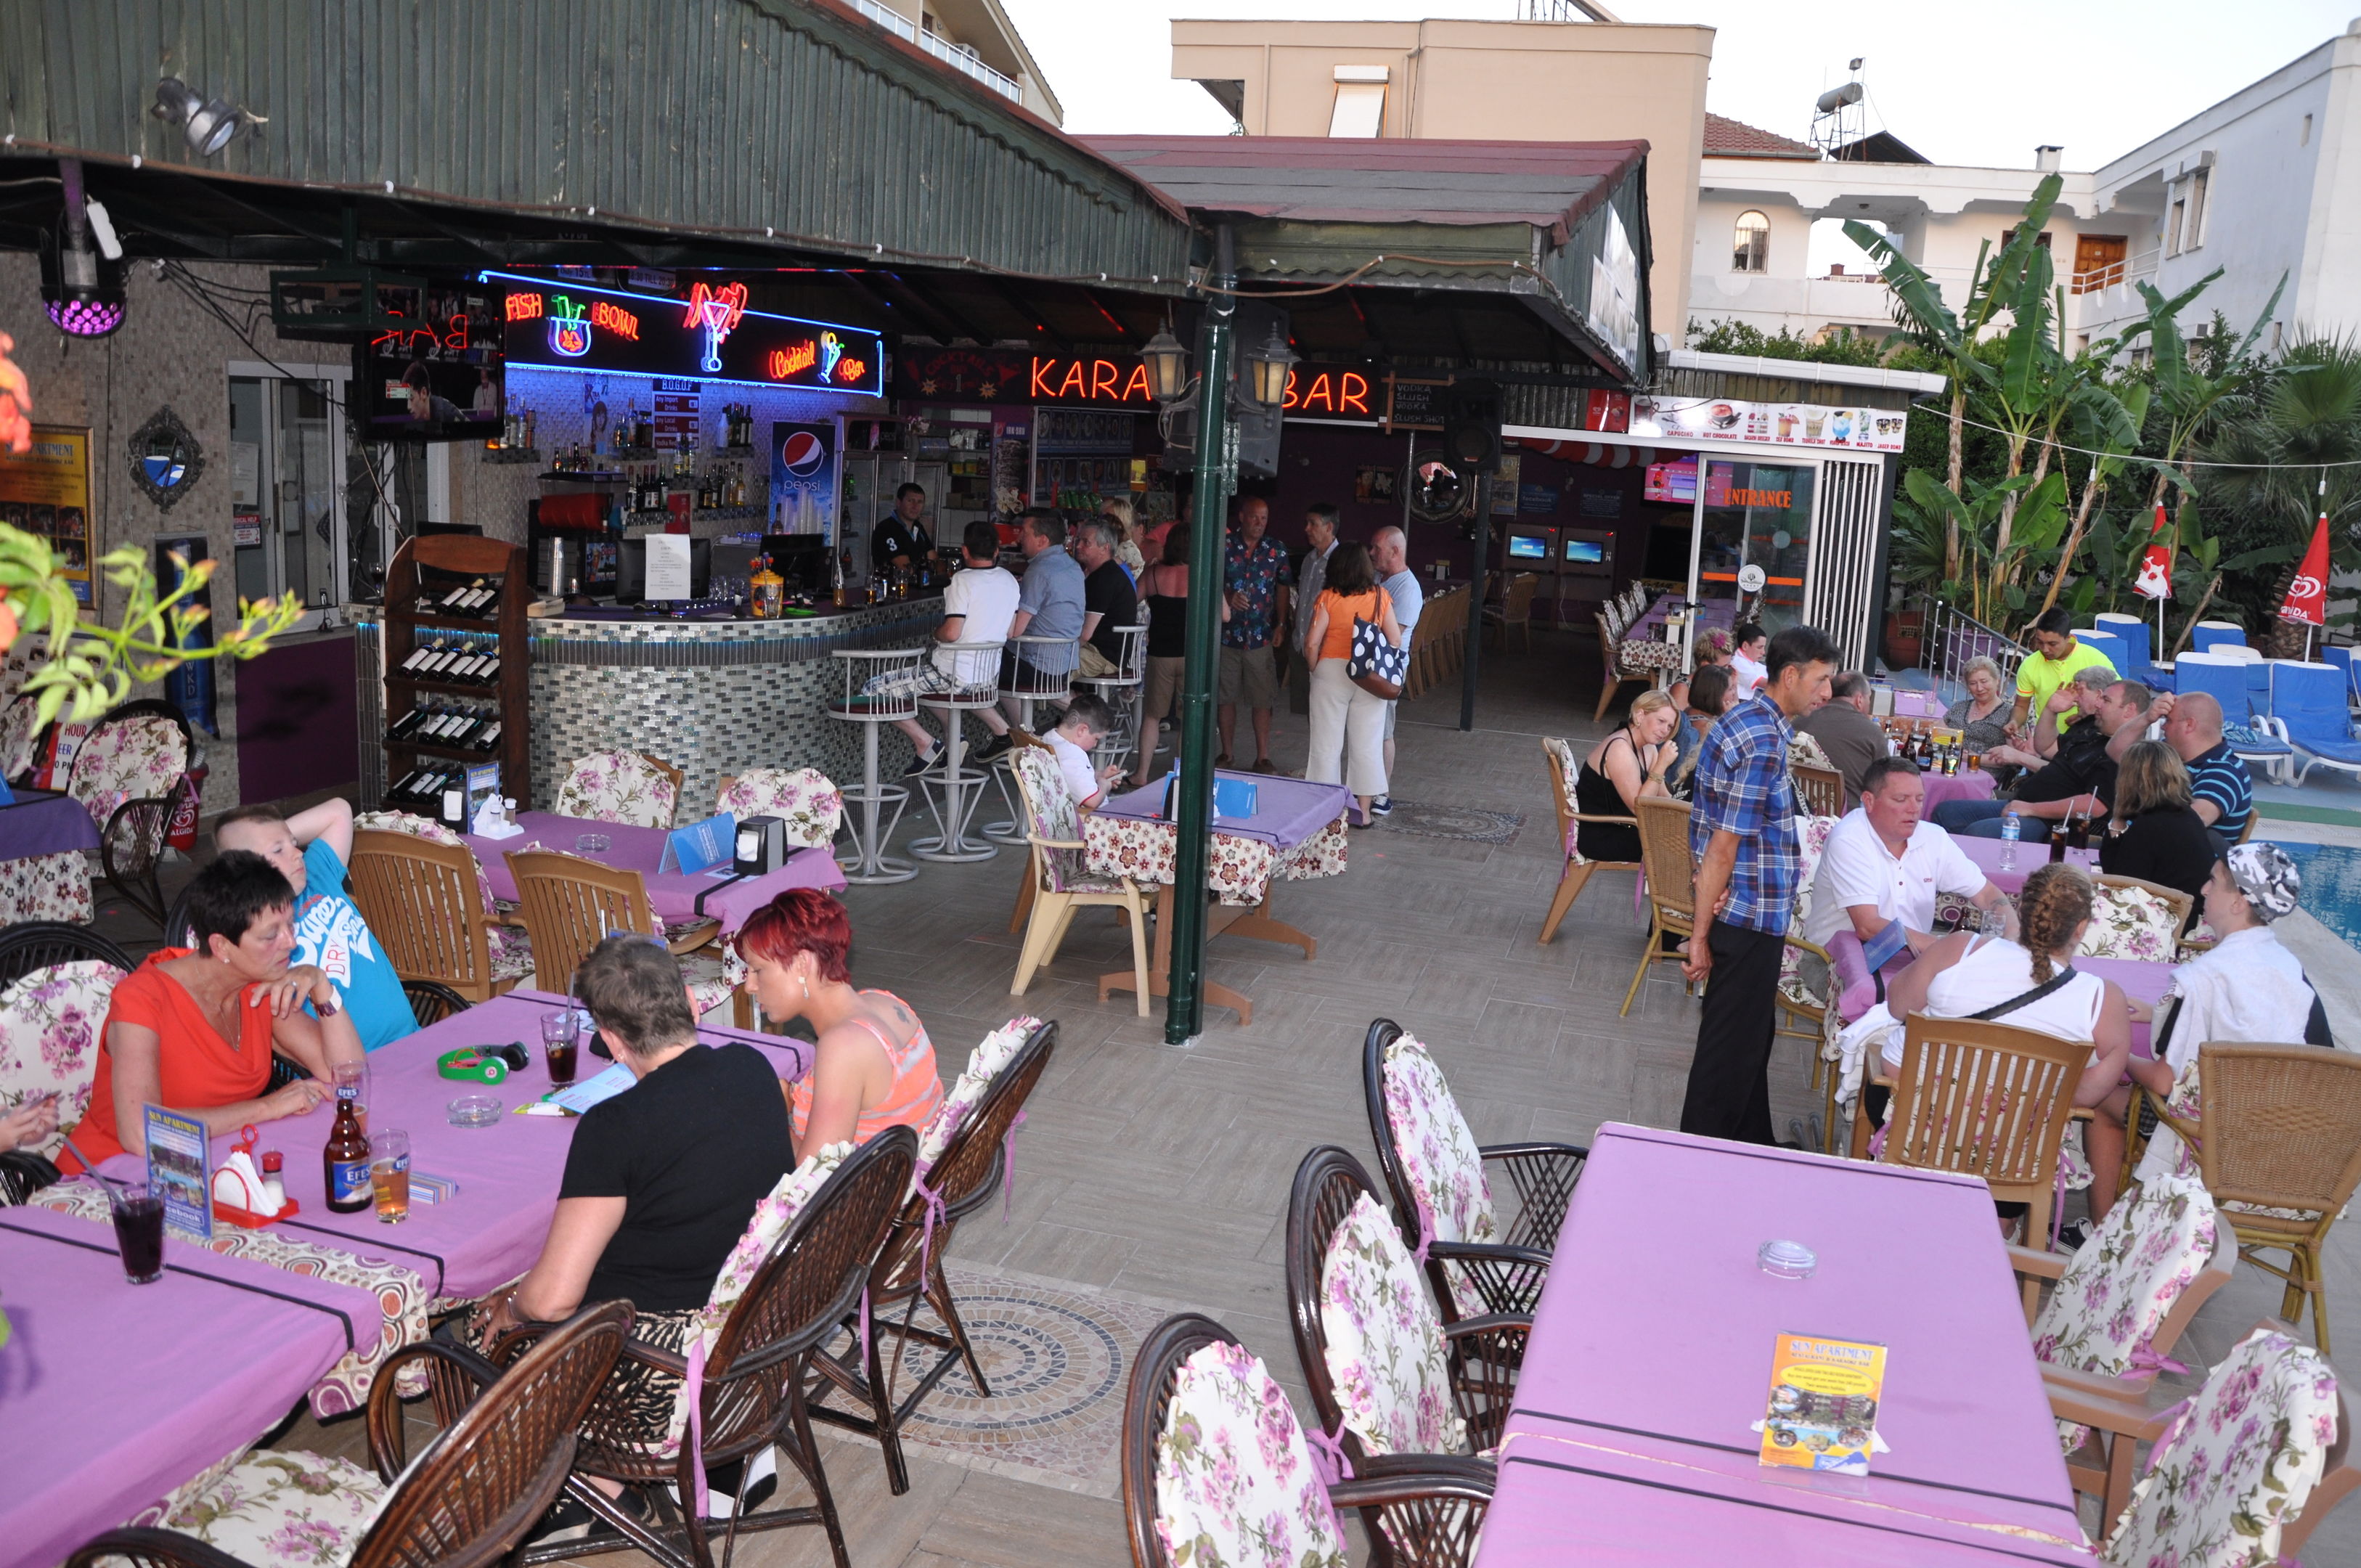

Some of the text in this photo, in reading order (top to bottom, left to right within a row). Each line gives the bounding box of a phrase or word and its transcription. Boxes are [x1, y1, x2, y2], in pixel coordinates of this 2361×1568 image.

[645, 273, 657, 284] TILL
[505, 293, 640, 341] FISH BOWL
[775, 340, 815, 379] Cocktail
[1030, 356, 1369, 414] KARA BAR
[1396, 384, 1432, 394] VODKA
[1396, 393, 1430, 402] SLUSH
[1394, 414, 1445, 424] SLUSH SHOT
[783, 480, 821, 491] pepsi
[1724, 487, 1793, 508] ENTRANCE
[886, 537, 898, 552] 3
[185, 661, 195, 696] WKD
[65, 724, 87, 738] HOUR
[58, 742, 72, 756] EER
[326, 939, 346, 976] DRY
[149, 1110, 200, 1135] SUN APARTMENT
[346, 1165, 370, 1181] EFES
[166, 1206, 201, 1222] cebook
[1791, 1341, 1873, 1360] SUN APARTMENT
